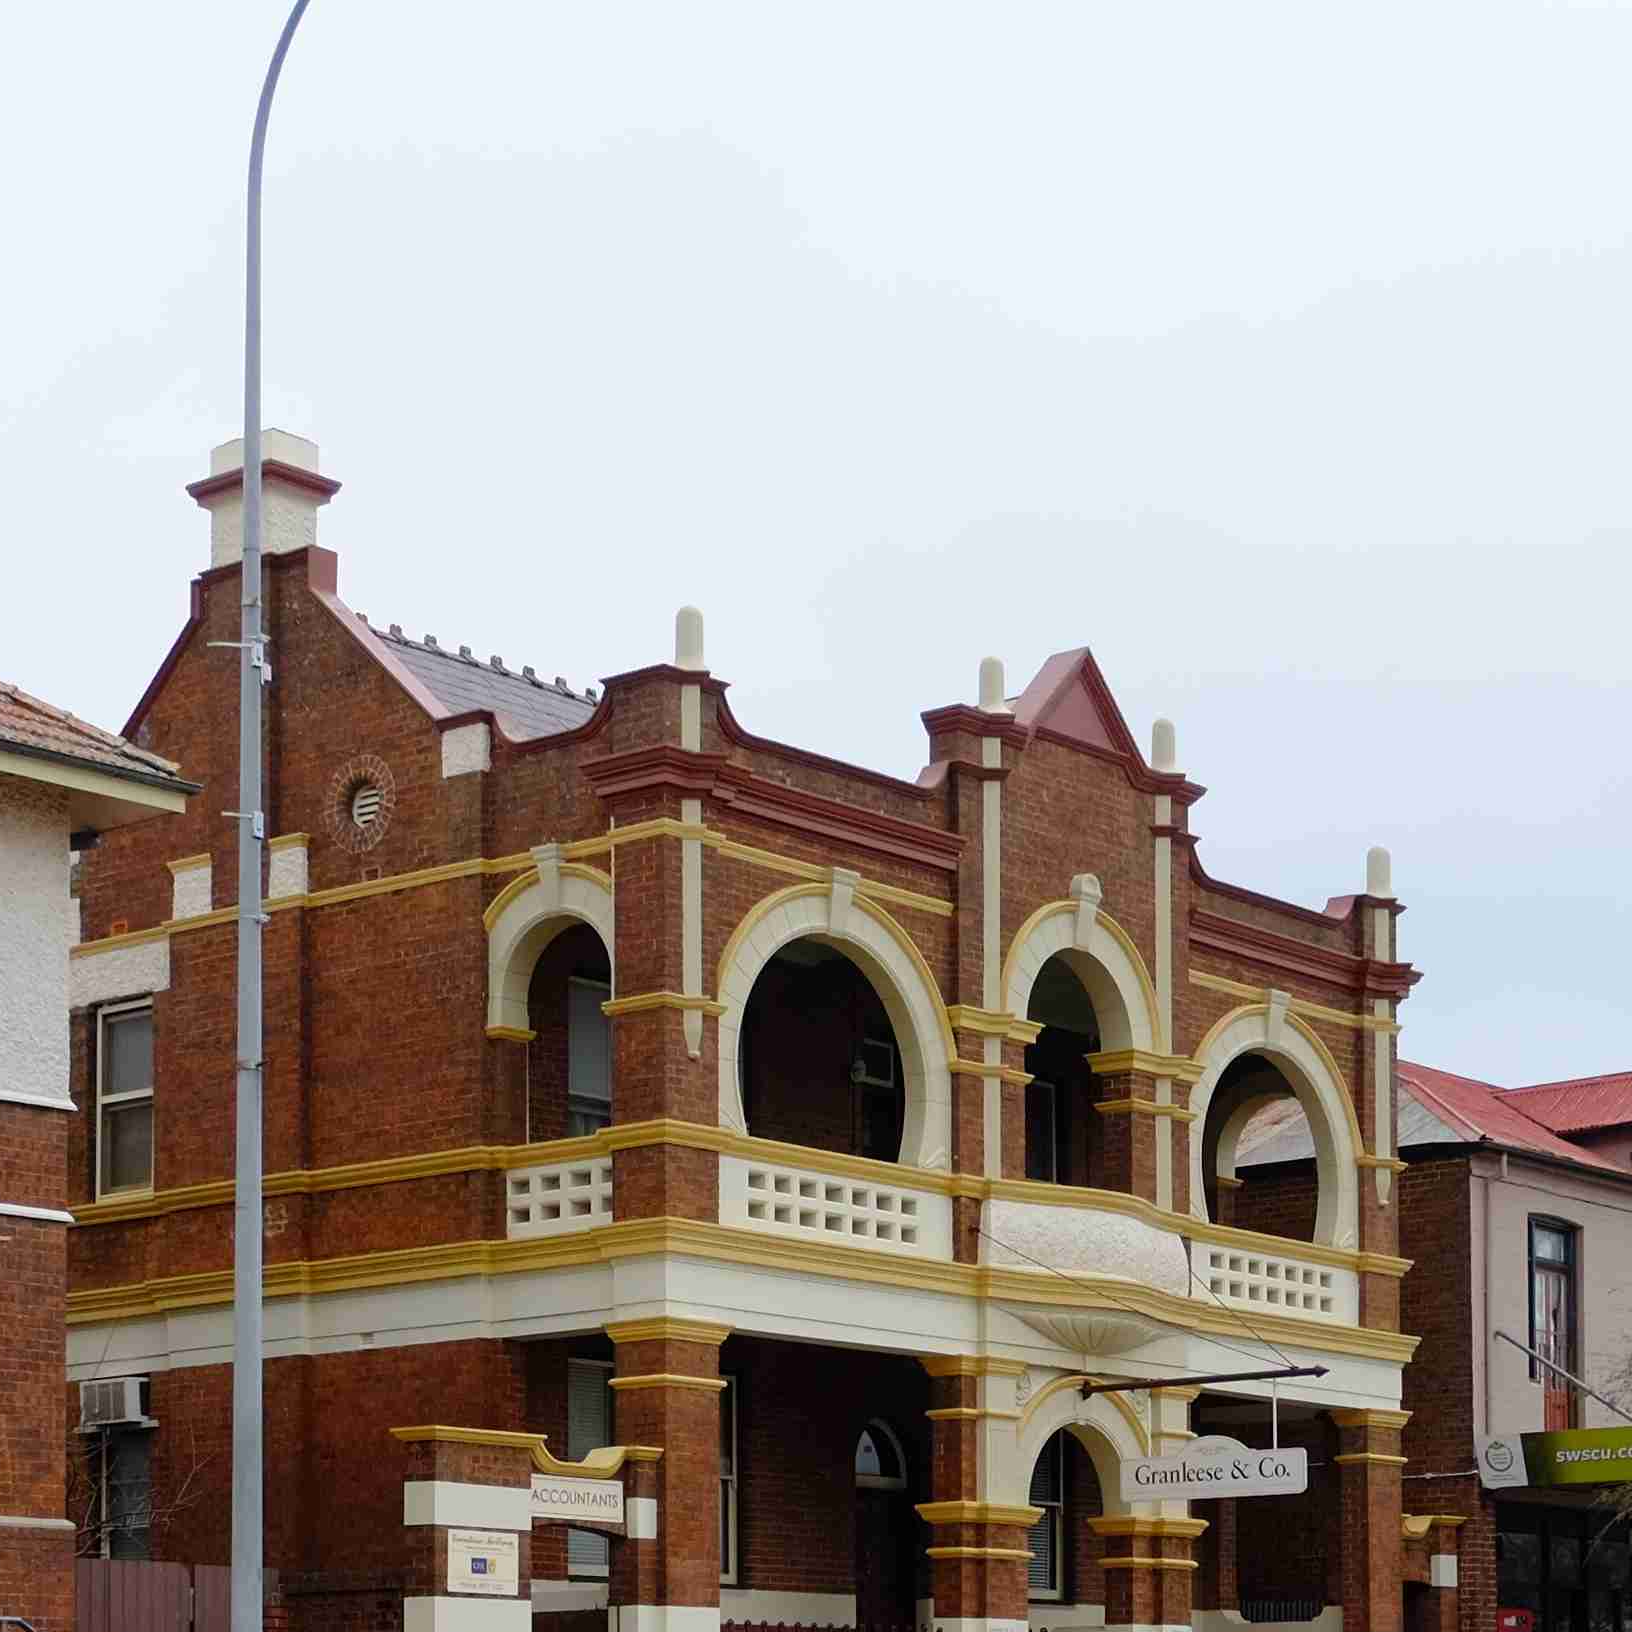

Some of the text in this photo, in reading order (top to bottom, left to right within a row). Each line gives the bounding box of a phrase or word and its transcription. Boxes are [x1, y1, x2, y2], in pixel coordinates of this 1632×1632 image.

[1135, 1457, 1291, 1486] Granleese & Co.
[531, 1488, 619, 1510] ACCOUNTANTS
